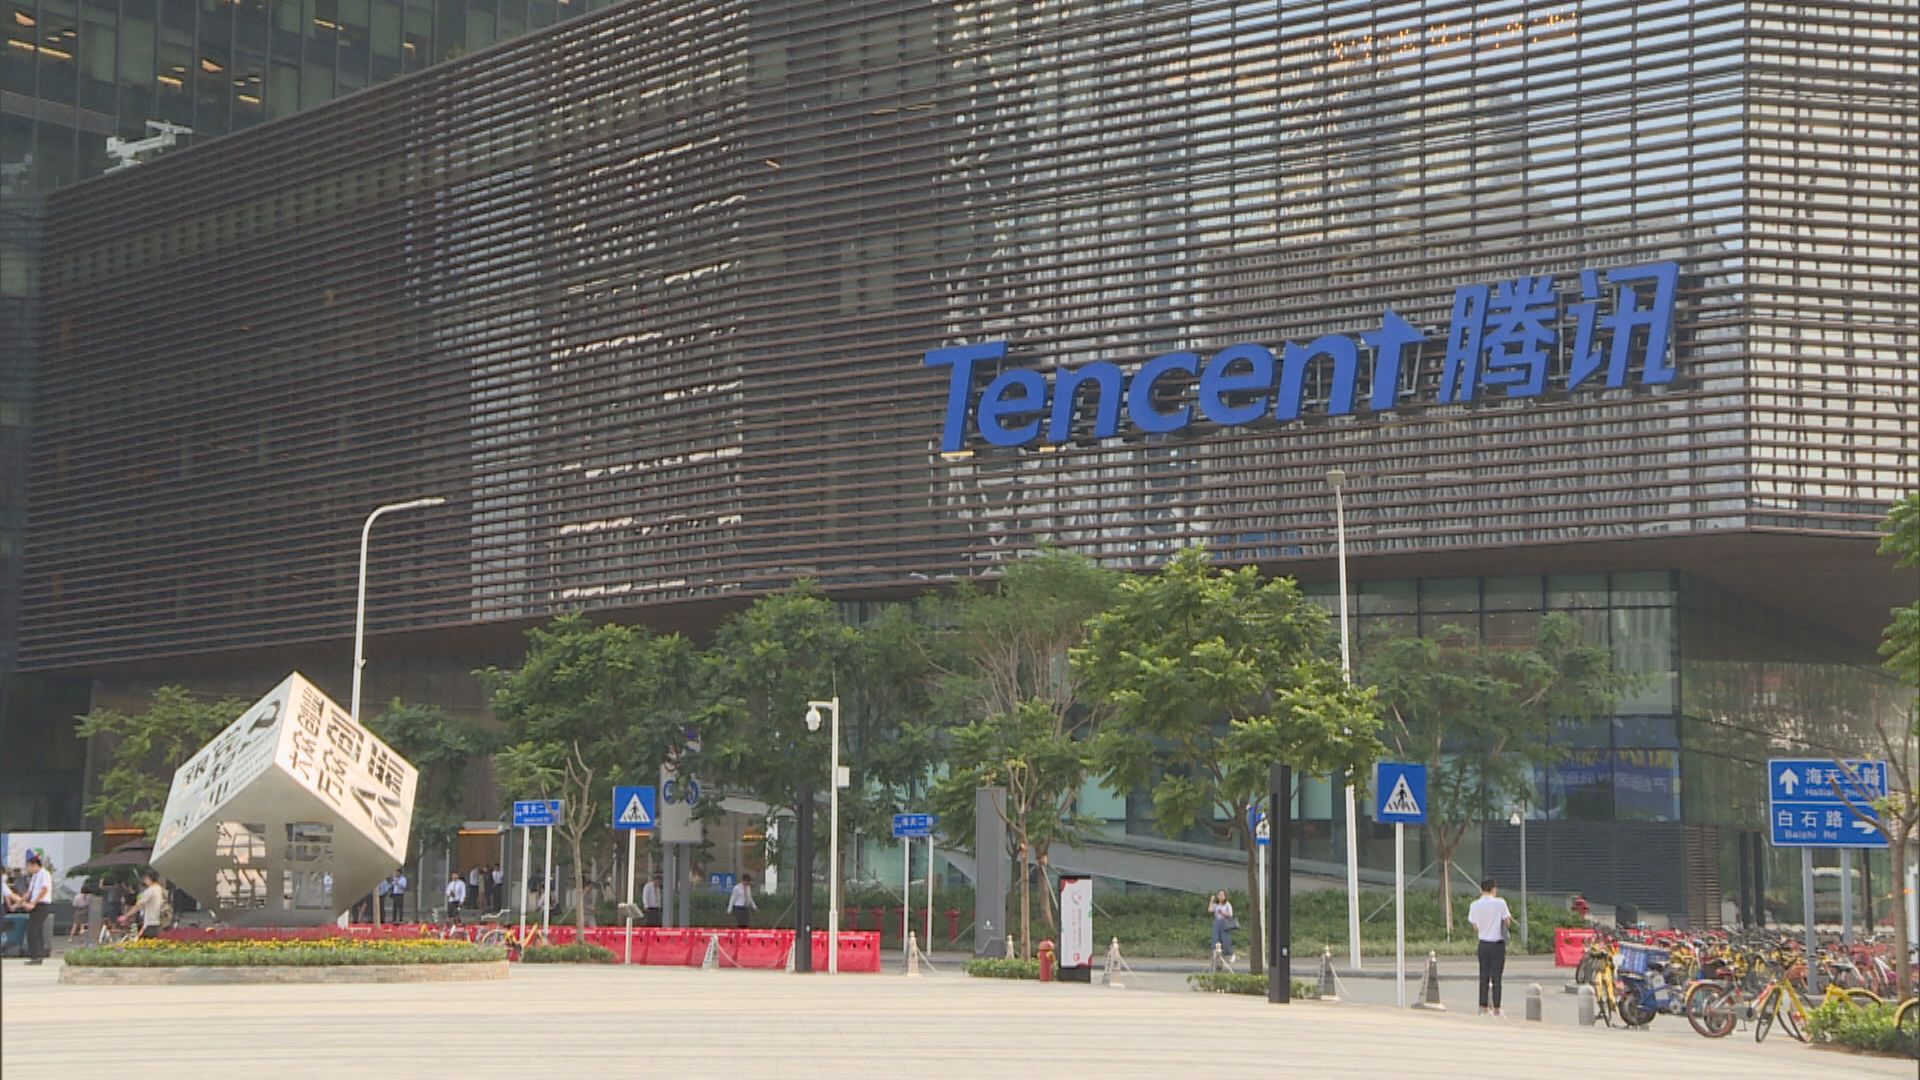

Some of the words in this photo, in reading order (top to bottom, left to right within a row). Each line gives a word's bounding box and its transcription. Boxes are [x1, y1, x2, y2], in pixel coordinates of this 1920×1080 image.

[924, 310, 1429, 452] Tencent
[1438, 261, 1680, 401] 腾讯
[1778, 810, 1842, 828] 白石路
[1785, 831, 1817, 839] Baishi
[1824, 831, 1837, 840] Rd
